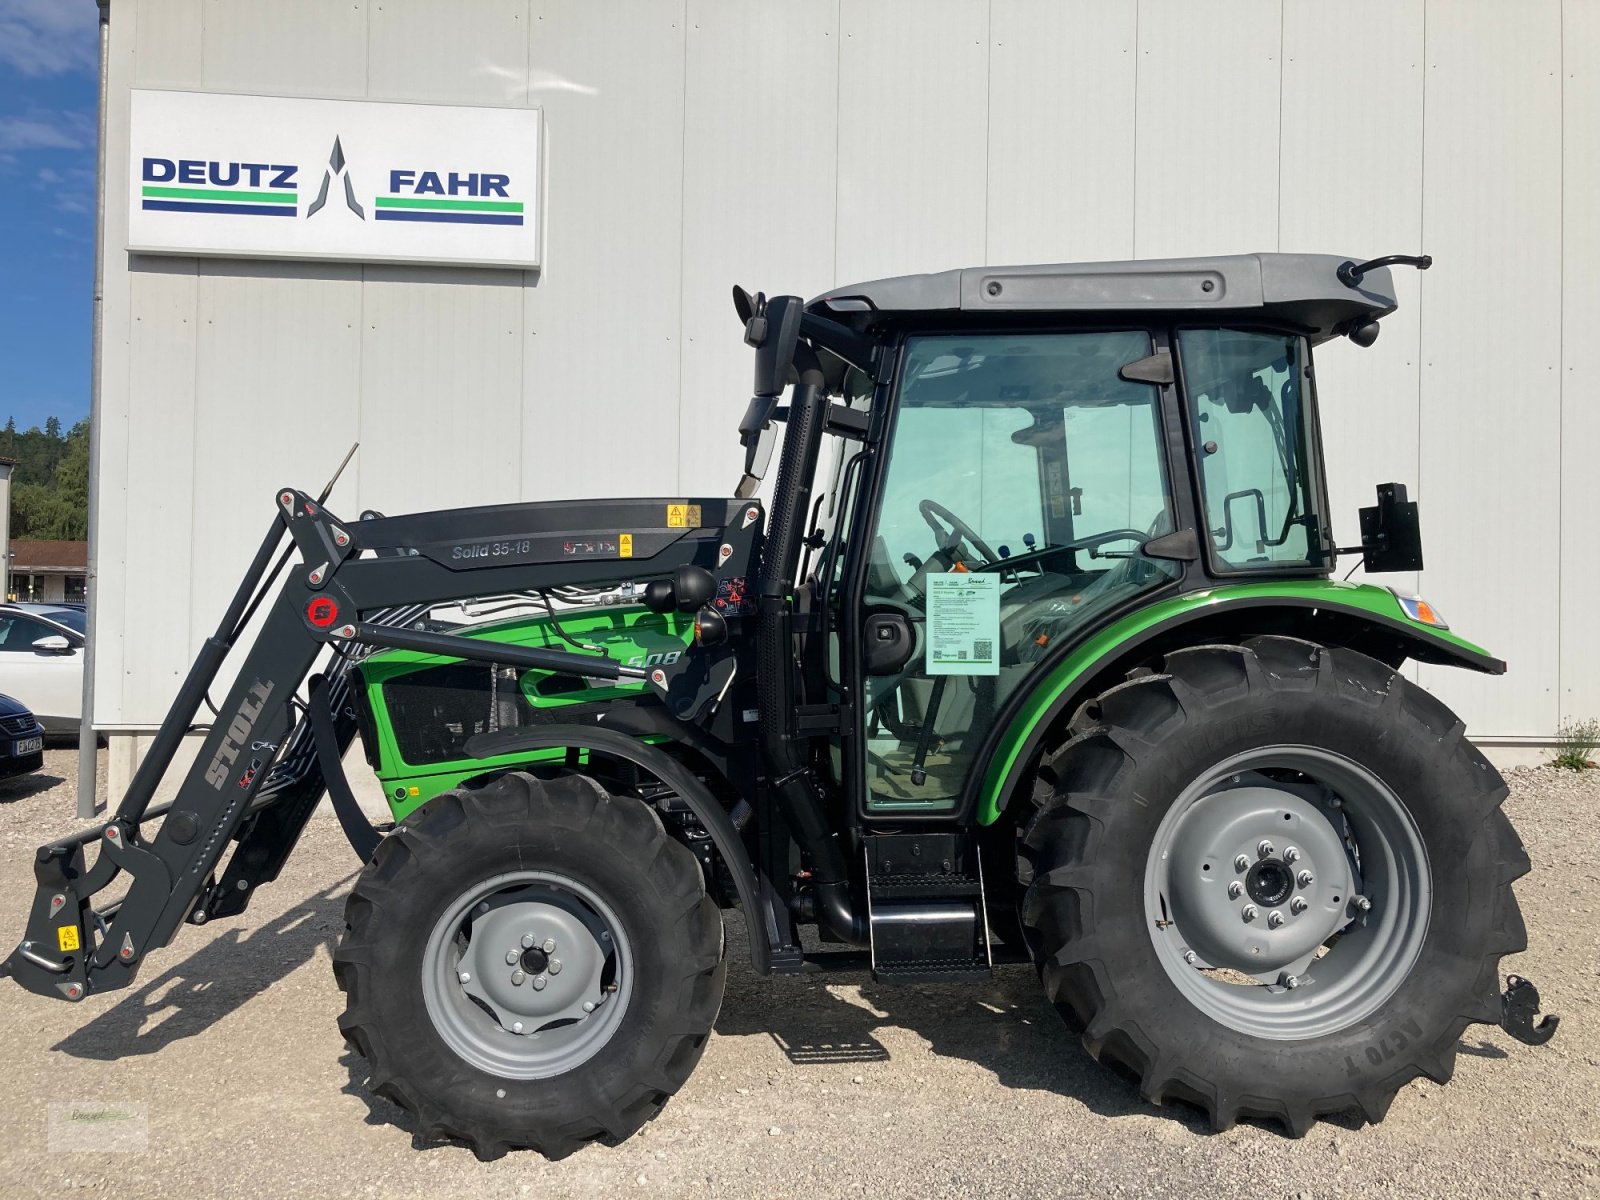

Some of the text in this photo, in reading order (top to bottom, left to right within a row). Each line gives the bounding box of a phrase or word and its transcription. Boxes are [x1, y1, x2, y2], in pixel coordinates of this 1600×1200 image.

[142, 157, 511, 198] DEUTZ FAHR
[451, 540, 530, 560] Solid 35-18
[204, 679, 276, 792] STOLL
[1364, 1017, 1424, 1067] AC70
